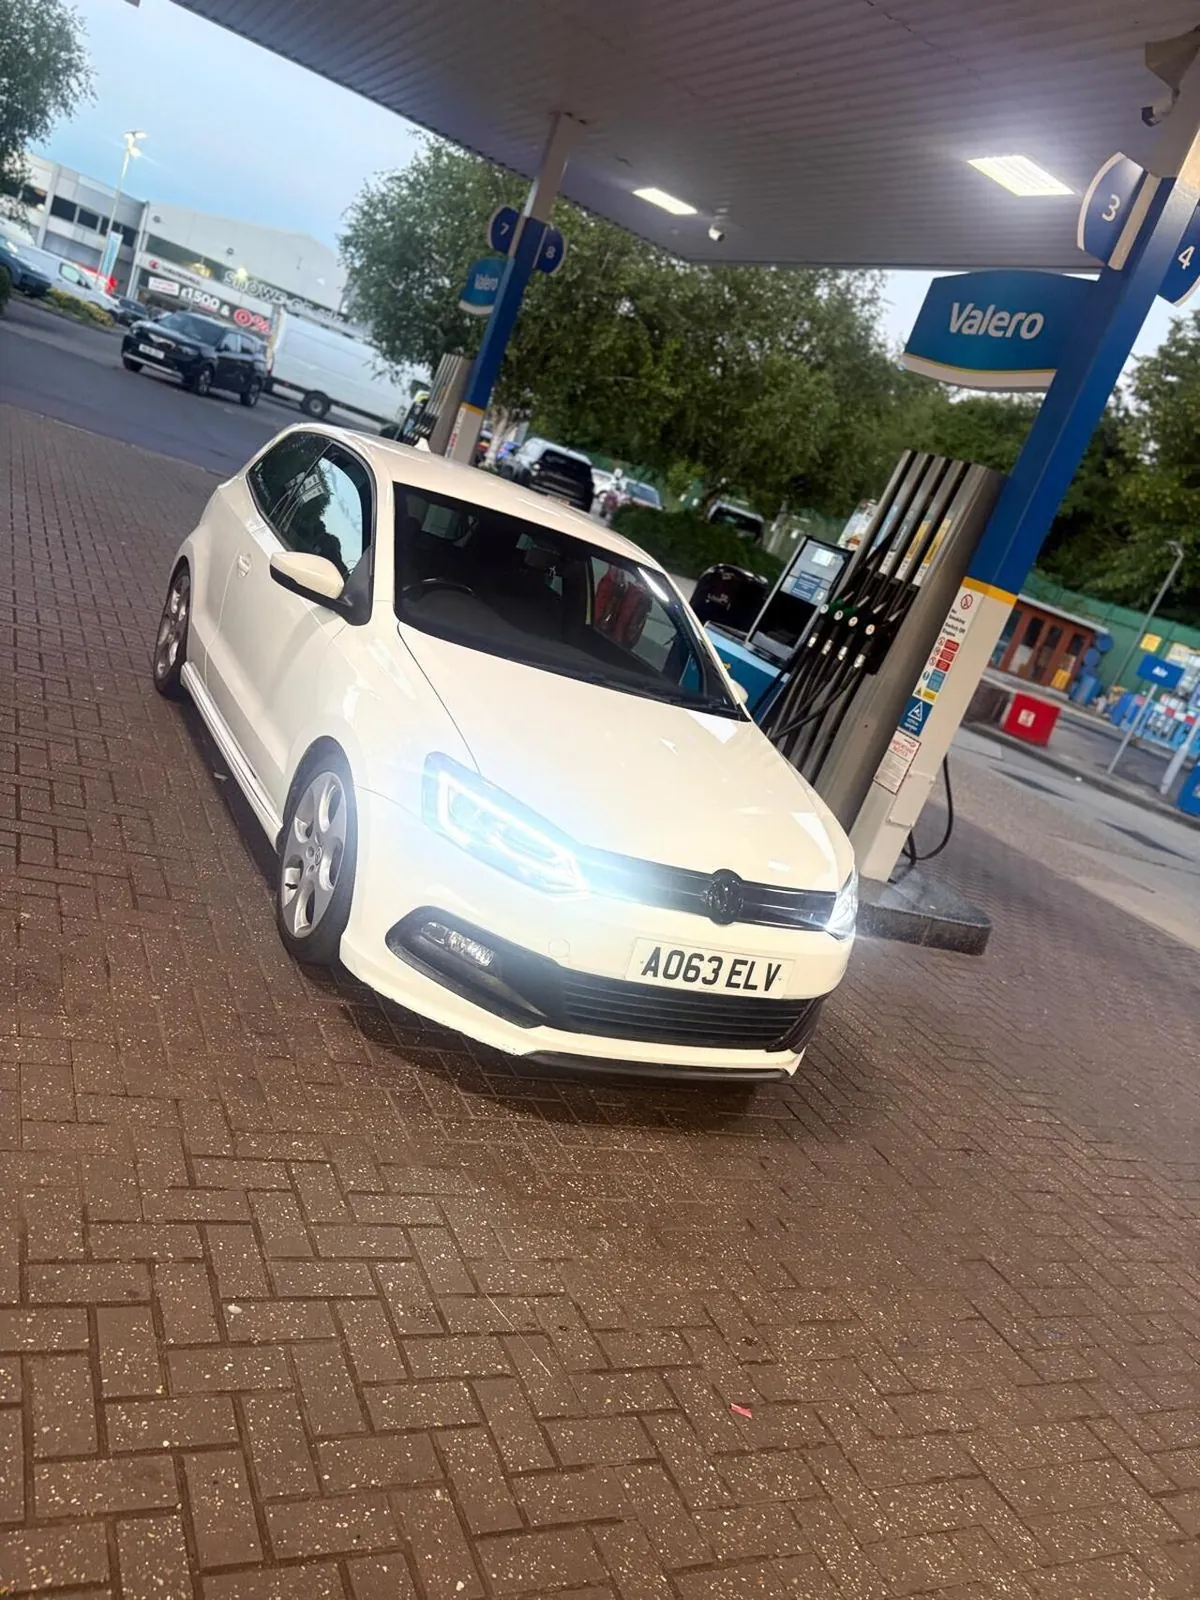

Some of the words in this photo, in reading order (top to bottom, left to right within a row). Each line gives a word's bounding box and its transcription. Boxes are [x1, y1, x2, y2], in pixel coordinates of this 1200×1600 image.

[1102, 194, 1121, 221] 3
[500, 222, 510, 235] 7
[546, 246, 556, 259] 8
[1177, 245, 1195, 270] 4
[948, 302, 1045, 341] Valero
[640, 946, 724, 985] AO63
[725, 959, 782, 992] ELV
